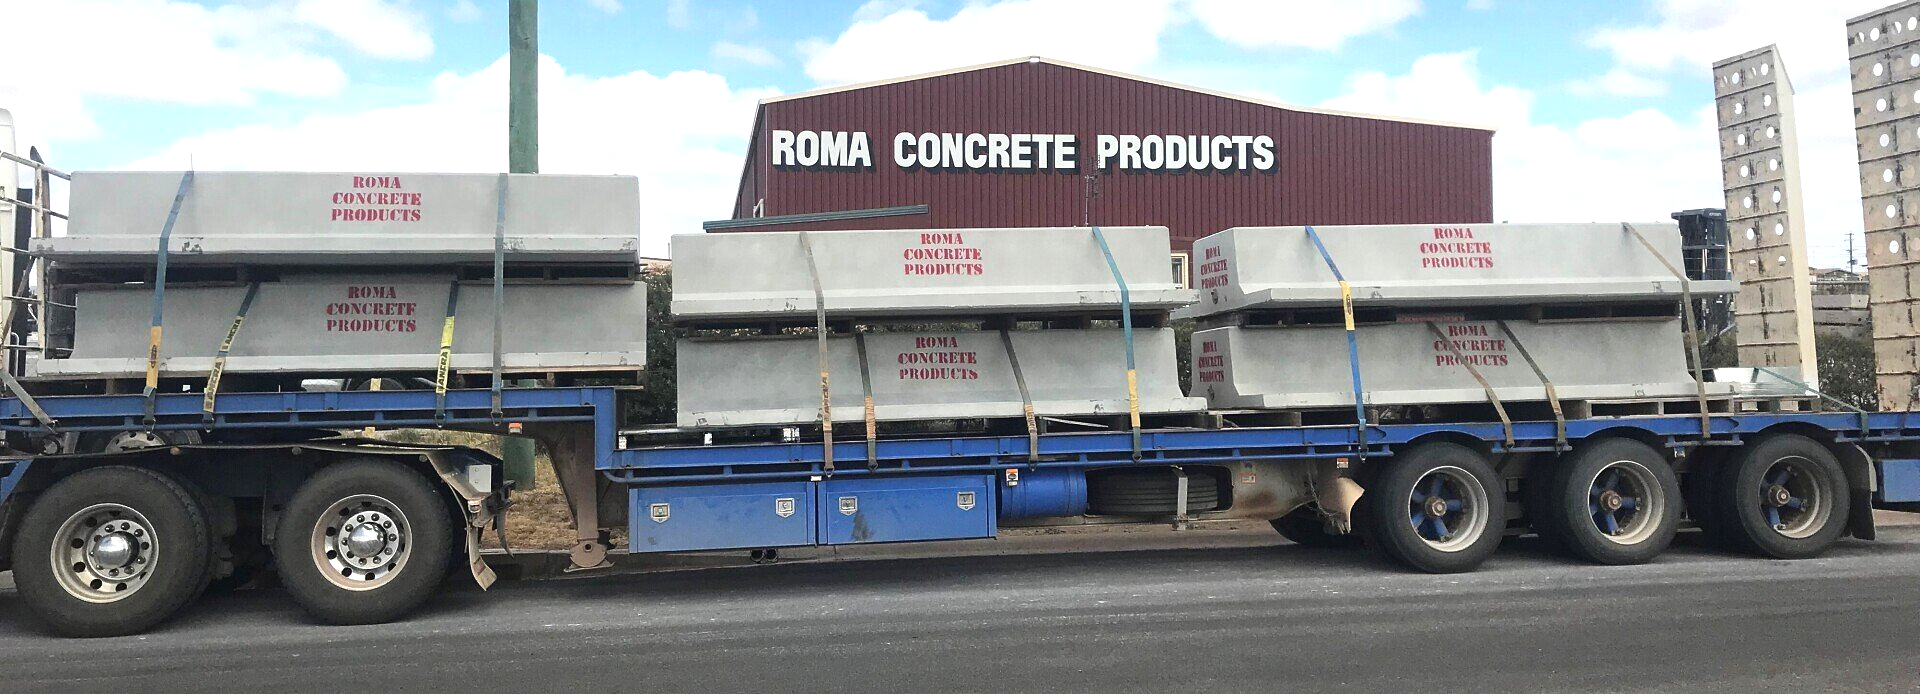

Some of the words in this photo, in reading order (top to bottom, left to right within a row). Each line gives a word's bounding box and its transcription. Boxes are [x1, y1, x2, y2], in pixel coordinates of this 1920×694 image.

[772, 130, 872, 167] ROMA
[894, 132, 1076, 169] CONCRETE
[1097, 134, 1275, 170] PRODUCTS
[353, 176, 401, 188] ROMA
[332, 192, 422, 205] CONCRETE
[331, 208, 421, 221] PRODUCTS
[920, 233, 963, 245] ROMA
[1434, 228, 1473, 239] ROMA
[903, 248, 982, 260] CONCRETE
[1420, 242, 1491, 254] CONCRETE
[1422, 257, 1494, 268] PRODUCTS
[904, 263, 983, 275] PRODUCTS
[348, 286, 397, 298] ROMA
[326, 319, 417, 332] PRODUCTS
[1448, 325, 1488, 336] ROMA
[915, 337, 958, 348] ROMA
[897, 352, 977, 364] CONCRETE
[438, 351, 449, 385] ANCRA
[899, 367, 978, 380] PRODUCTS
